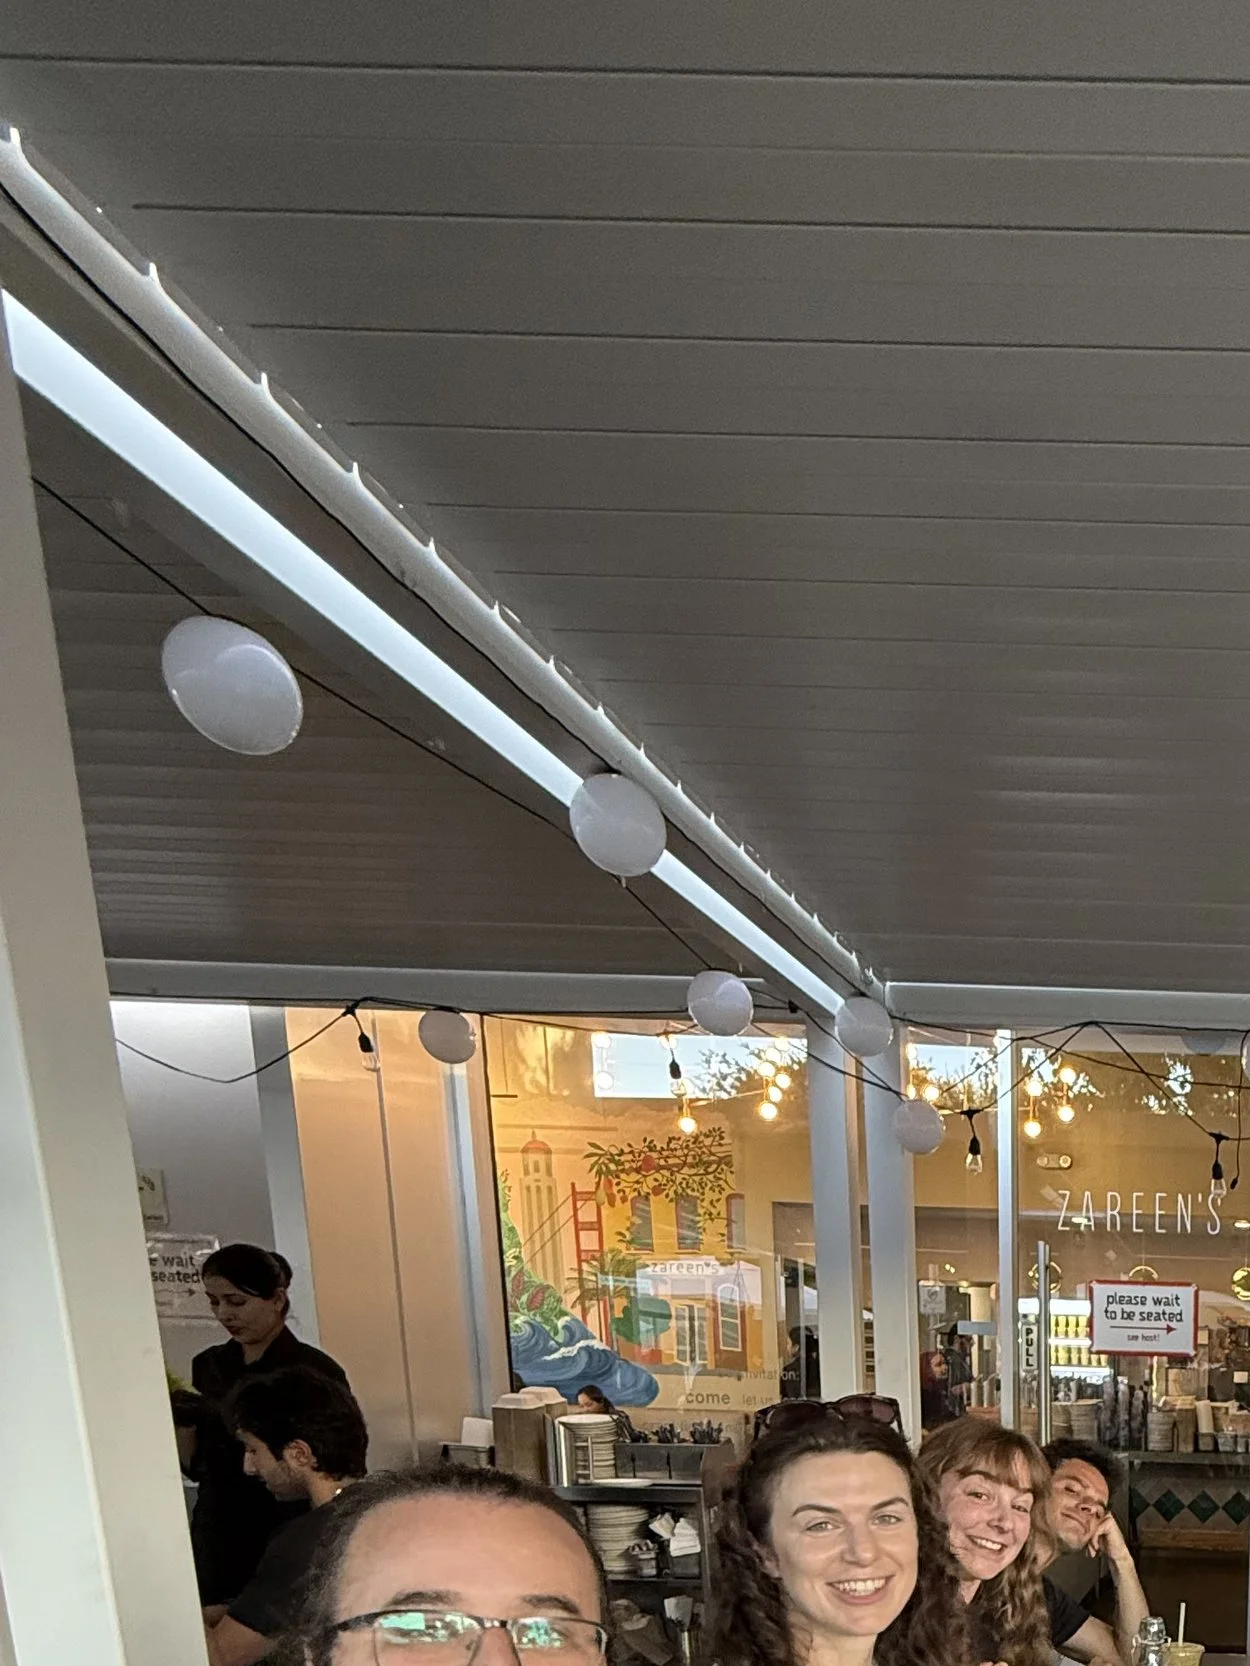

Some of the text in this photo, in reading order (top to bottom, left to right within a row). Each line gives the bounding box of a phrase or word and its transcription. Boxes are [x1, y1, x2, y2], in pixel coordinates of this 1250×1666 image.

[1057, 1190, 1221, 1235] ZAREEN'S
[163, 1254, 194, 1267] wait
[152, 1270, 200, 1283] seated
[1106, 1292, 1181, 1308] please wait
[1104, 1307, 1184, 1323] to be seated
[1025, 1328, 1034, 1367] PULL
[686, 1392, 731, 1405] come
